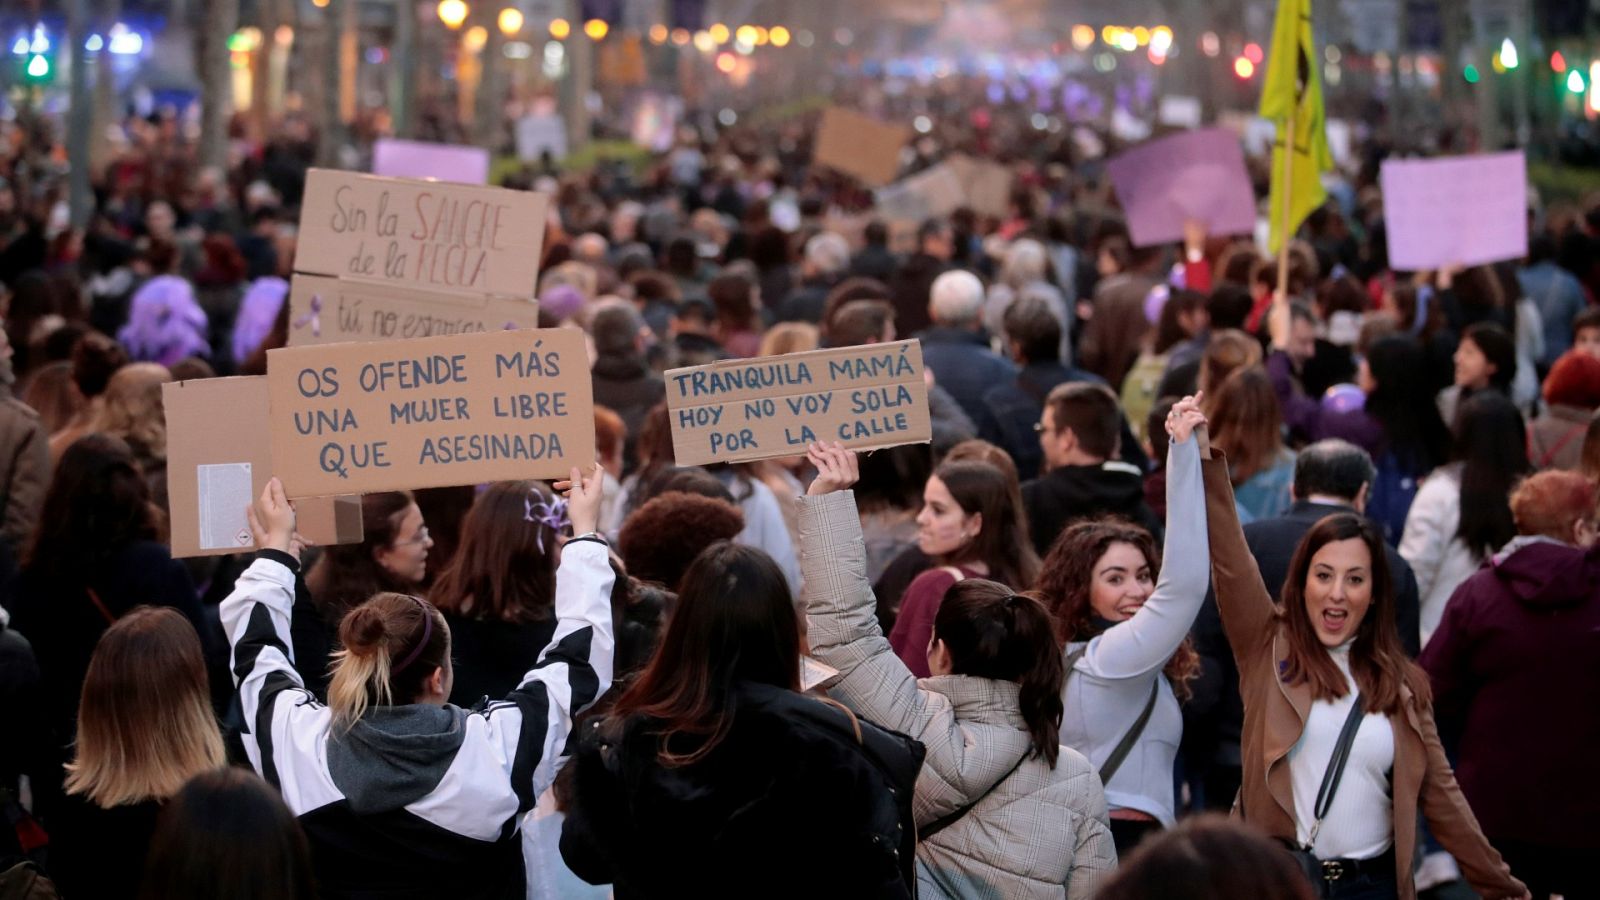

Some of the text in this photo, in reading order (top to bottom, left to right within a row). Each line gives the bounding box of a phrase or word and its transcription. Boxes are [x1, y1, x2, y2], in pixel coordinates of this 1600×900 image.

[331, 185, 511, 251] Sin la SANGRE
[350, 240, 487, 287] de la REGLA
[338, 297, 363, 334] tú
[371, 310, 399, 338] no
[298, 340, 561, 398] OS OFENDE MÁS
[672, 343, 915, 398] TRANQUILA MAMÁ
[294, 392, 569, 436] UNA MUJER LIBRE
[679, 384, 914, 430] HOY NO VOY SOLA
[319, 432, 564, 479] QUE ASESINADA
[710, 412, 909, 456] POR LA CALLE
